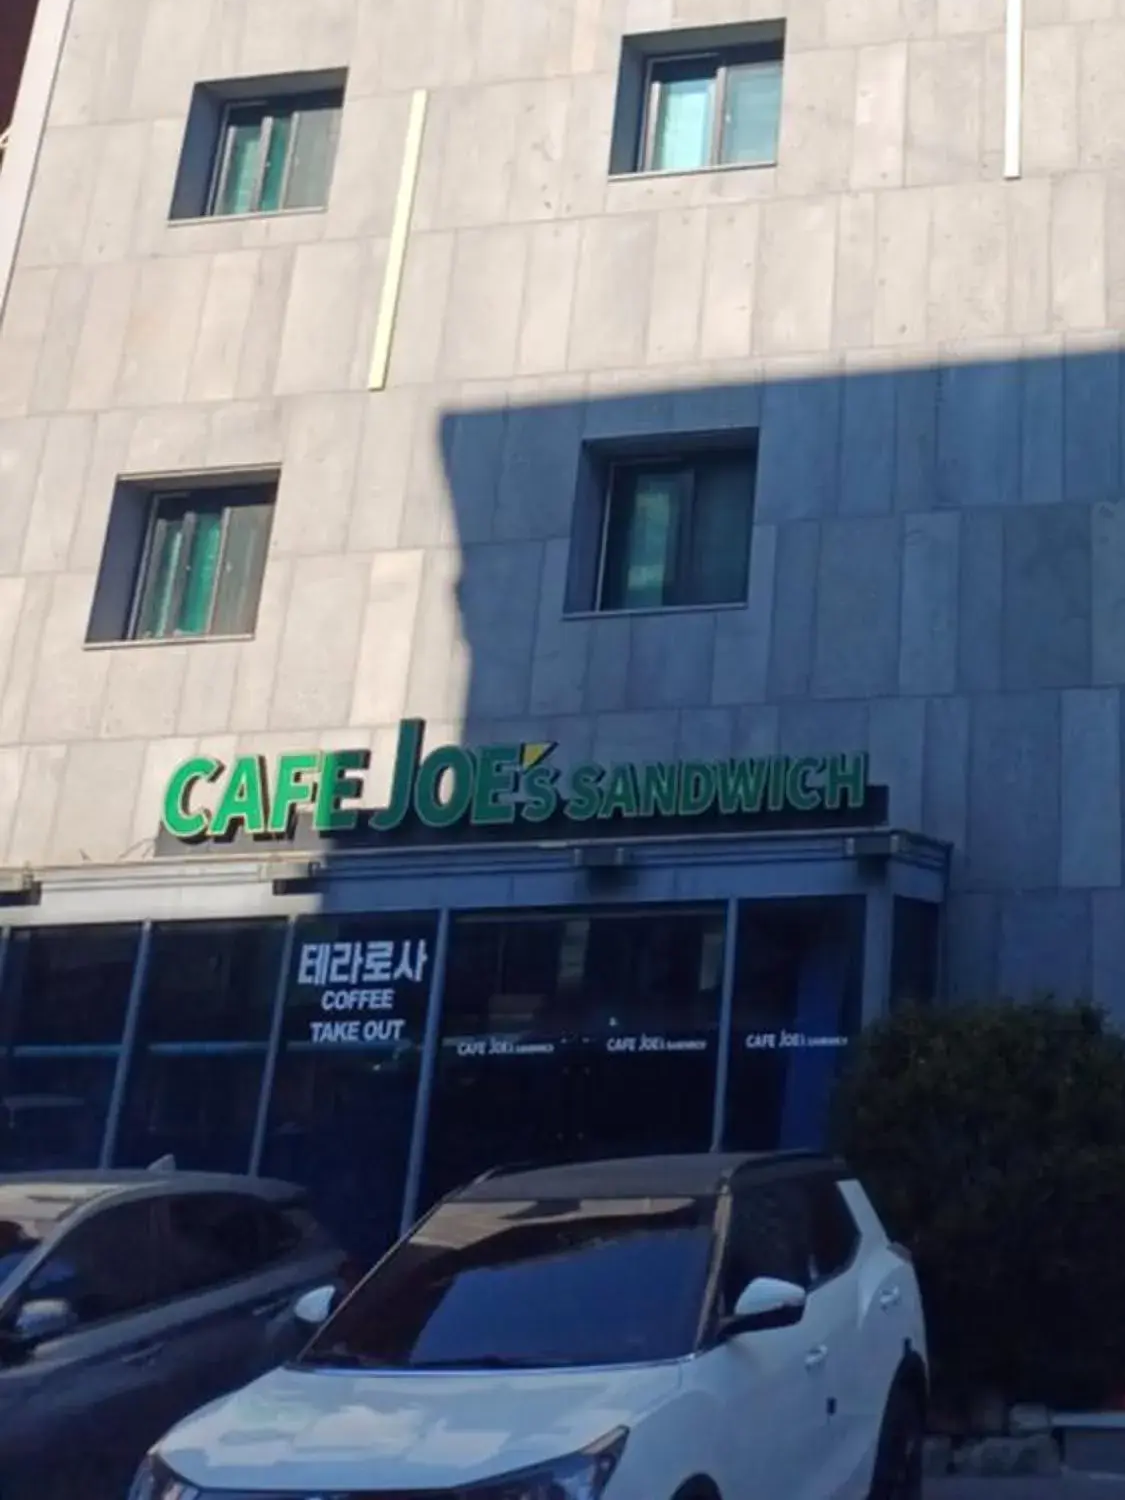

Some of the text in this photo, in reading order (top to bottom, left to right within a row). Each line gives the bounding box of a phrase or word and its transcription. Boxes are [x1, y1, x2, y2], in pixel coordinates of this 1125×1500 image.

[163, 748, 370, 841] CAFE
[563, 750, 868, 819] SANDWICH
[298, 938, 428, 986] 테라로사
[321, 988, 395, 1011] COFFEE
[310, 1018, 405, 1044] TAKE OUT
